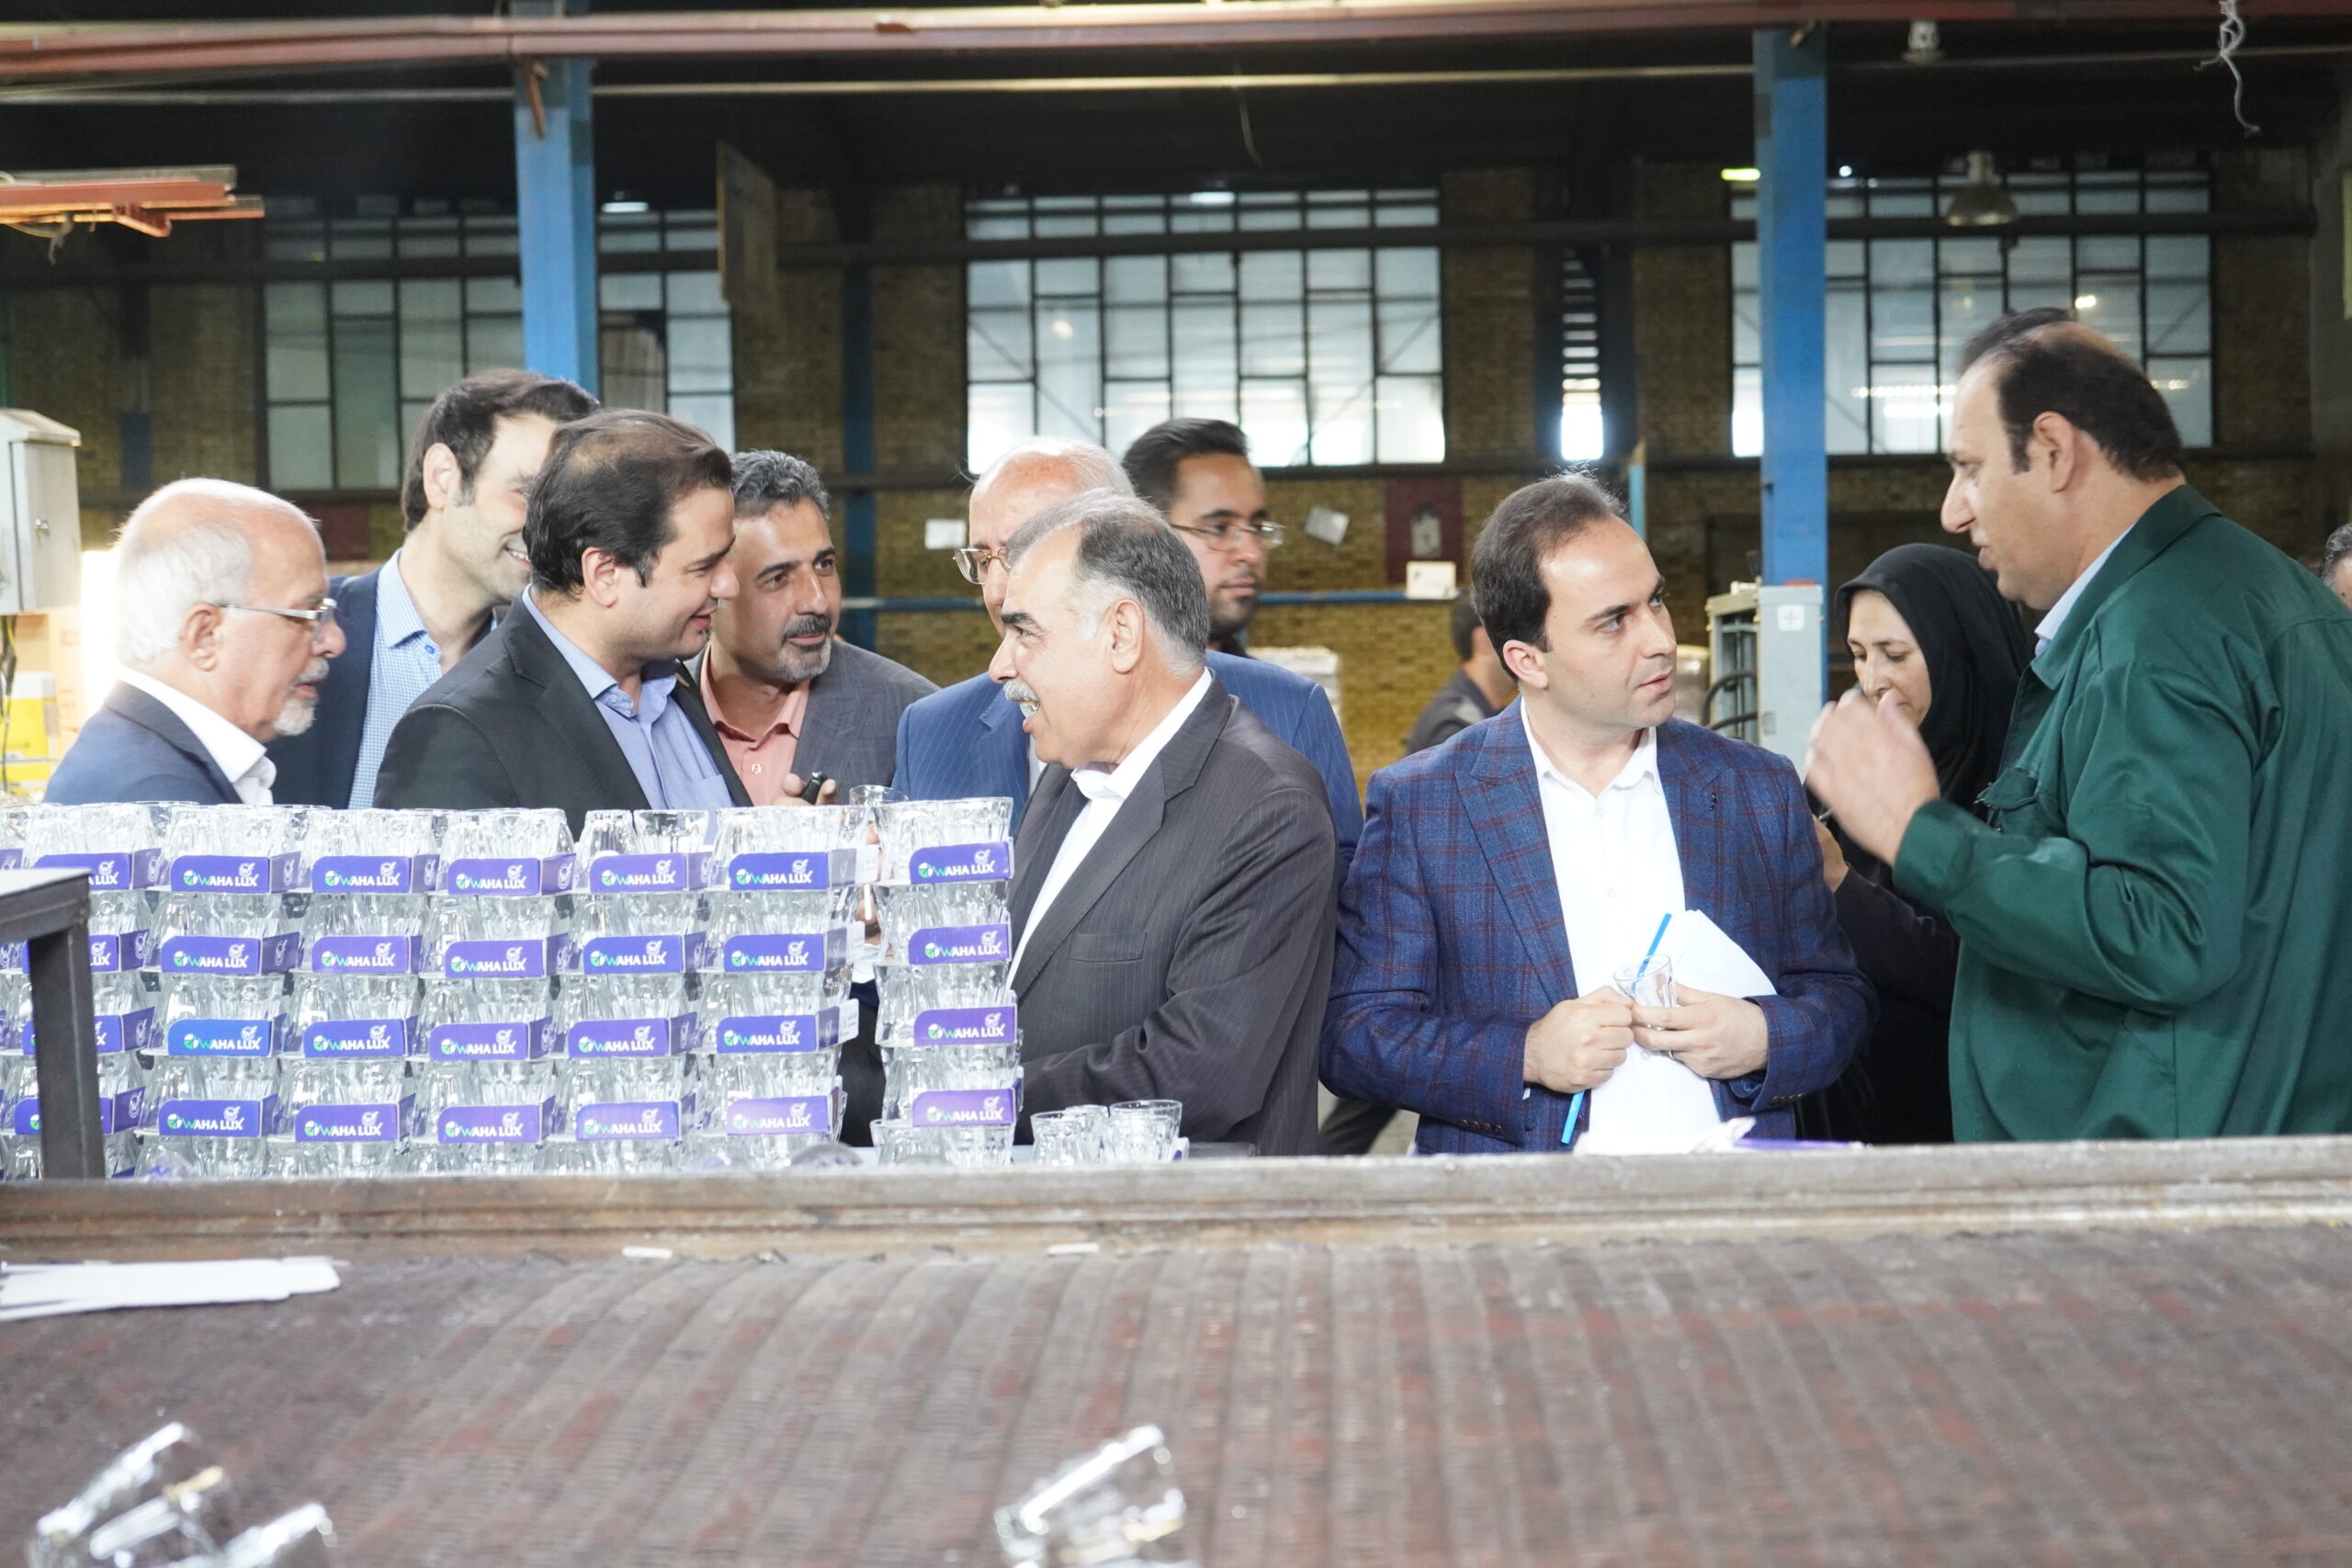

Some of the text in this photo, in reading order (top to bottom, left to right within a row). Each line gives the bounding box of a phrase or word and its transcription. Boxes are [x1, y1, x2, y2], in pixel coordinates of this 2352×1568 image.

[933, 860, 996, 876] WAHA LUX
[96, 872, 119, 885] LUX
[198, 874, 259, 886] WAHA LUX
[339, 873, 401, 886] WAHA LUX
[469, 876, 527, 889] WAHA LUX
[616, 871, 676, 886] WAHA LUX
[750, 870, 813, 885] WAHA LUX
[938, 942, 1002, 957] WAHA LUX
[187, 954, 249, 968] WAHA LUX
[335, 953, 395, 966] WAHA LUX
[466, 958, 527, 972] WAHA LUX
[604, 951, 667, 965] WAHA LUX
[745, 953, 809, 966] WAHA LUX
[940, 1023, 1006, 1039] WAHA LUX
[198, 1036, 263, 1049] WAHA LUX
[328, 1036, 392, 1050] WAHA LUX
[594, 1037, 655, 1052] WAHA LUX
[738, 1032, 801, 1045] WAHA LUX
[455, 1041, 516, 1055] WAHA LUX
[747, 1114, 812, 1128] WAHA LUX
[940, 1107, 1004, 1122] WAHA LUX
[182, 1118, 245, 1131] WAHA LUX
[319, 1122, 383, 1136] WAHA LUX
[459, 1123, 525, 1137] WAHA LUX
[599, 1121, 662, 1134] WAHA LUX
